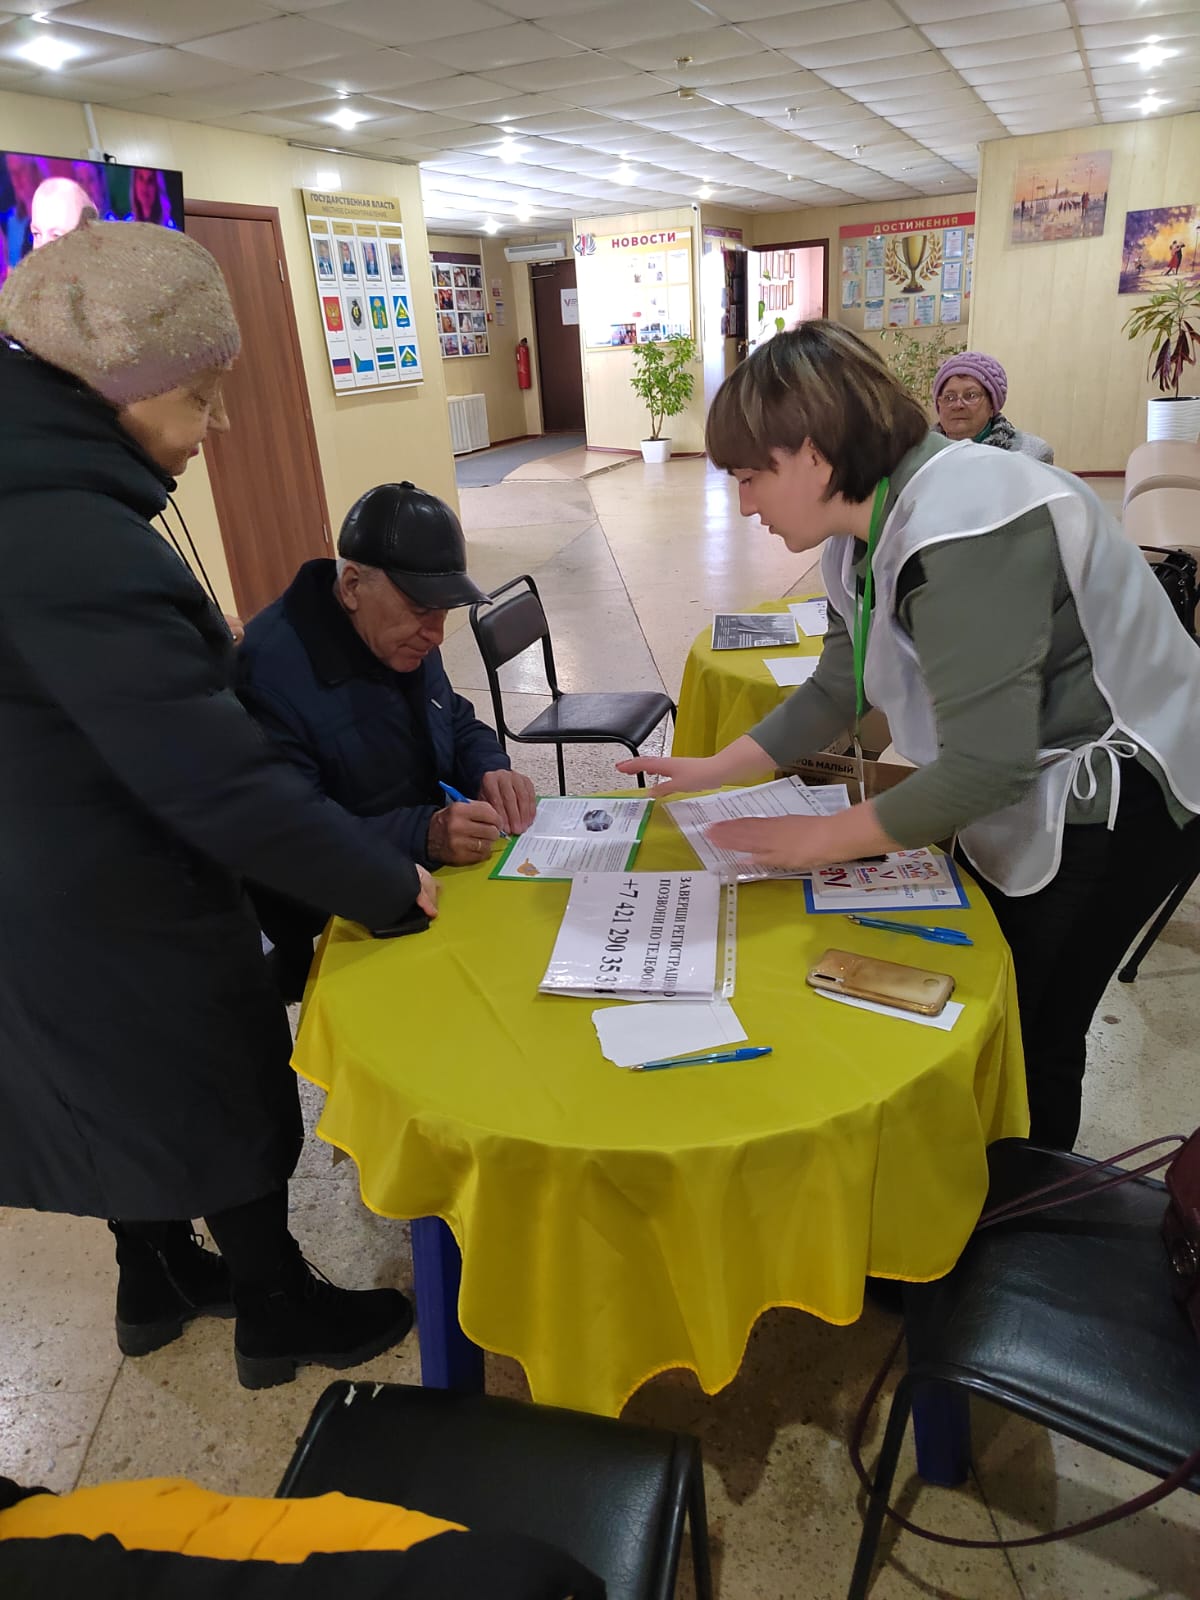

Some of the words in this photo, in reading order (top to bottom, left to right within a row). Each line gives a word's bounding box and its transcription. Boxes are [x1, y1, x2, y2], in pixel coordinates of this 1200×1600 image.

[310, 193, 371, 208] ГОСУДАРСТВЕННАЯ
[371, 201, 395, 210] ВЛАСТЬ
[873, 216, 959, 234] ДОСТИЖЕНИЯ
[611, 232, 677, 249] НОВОСТИ
[815, 761, 854, 774] МАЛЫЙ
[619, 879, 639, 899] +7
[652, 879, 671, 924] ПОЗВОНИ
[674, 876, 692, 923] ЗАВЕРШИ
[612, 902, 635, 923] 421
[604, 928, 630, 952] 290
[649, 926, 663, 940] ПО
[599, 956, 623, 973] 35
